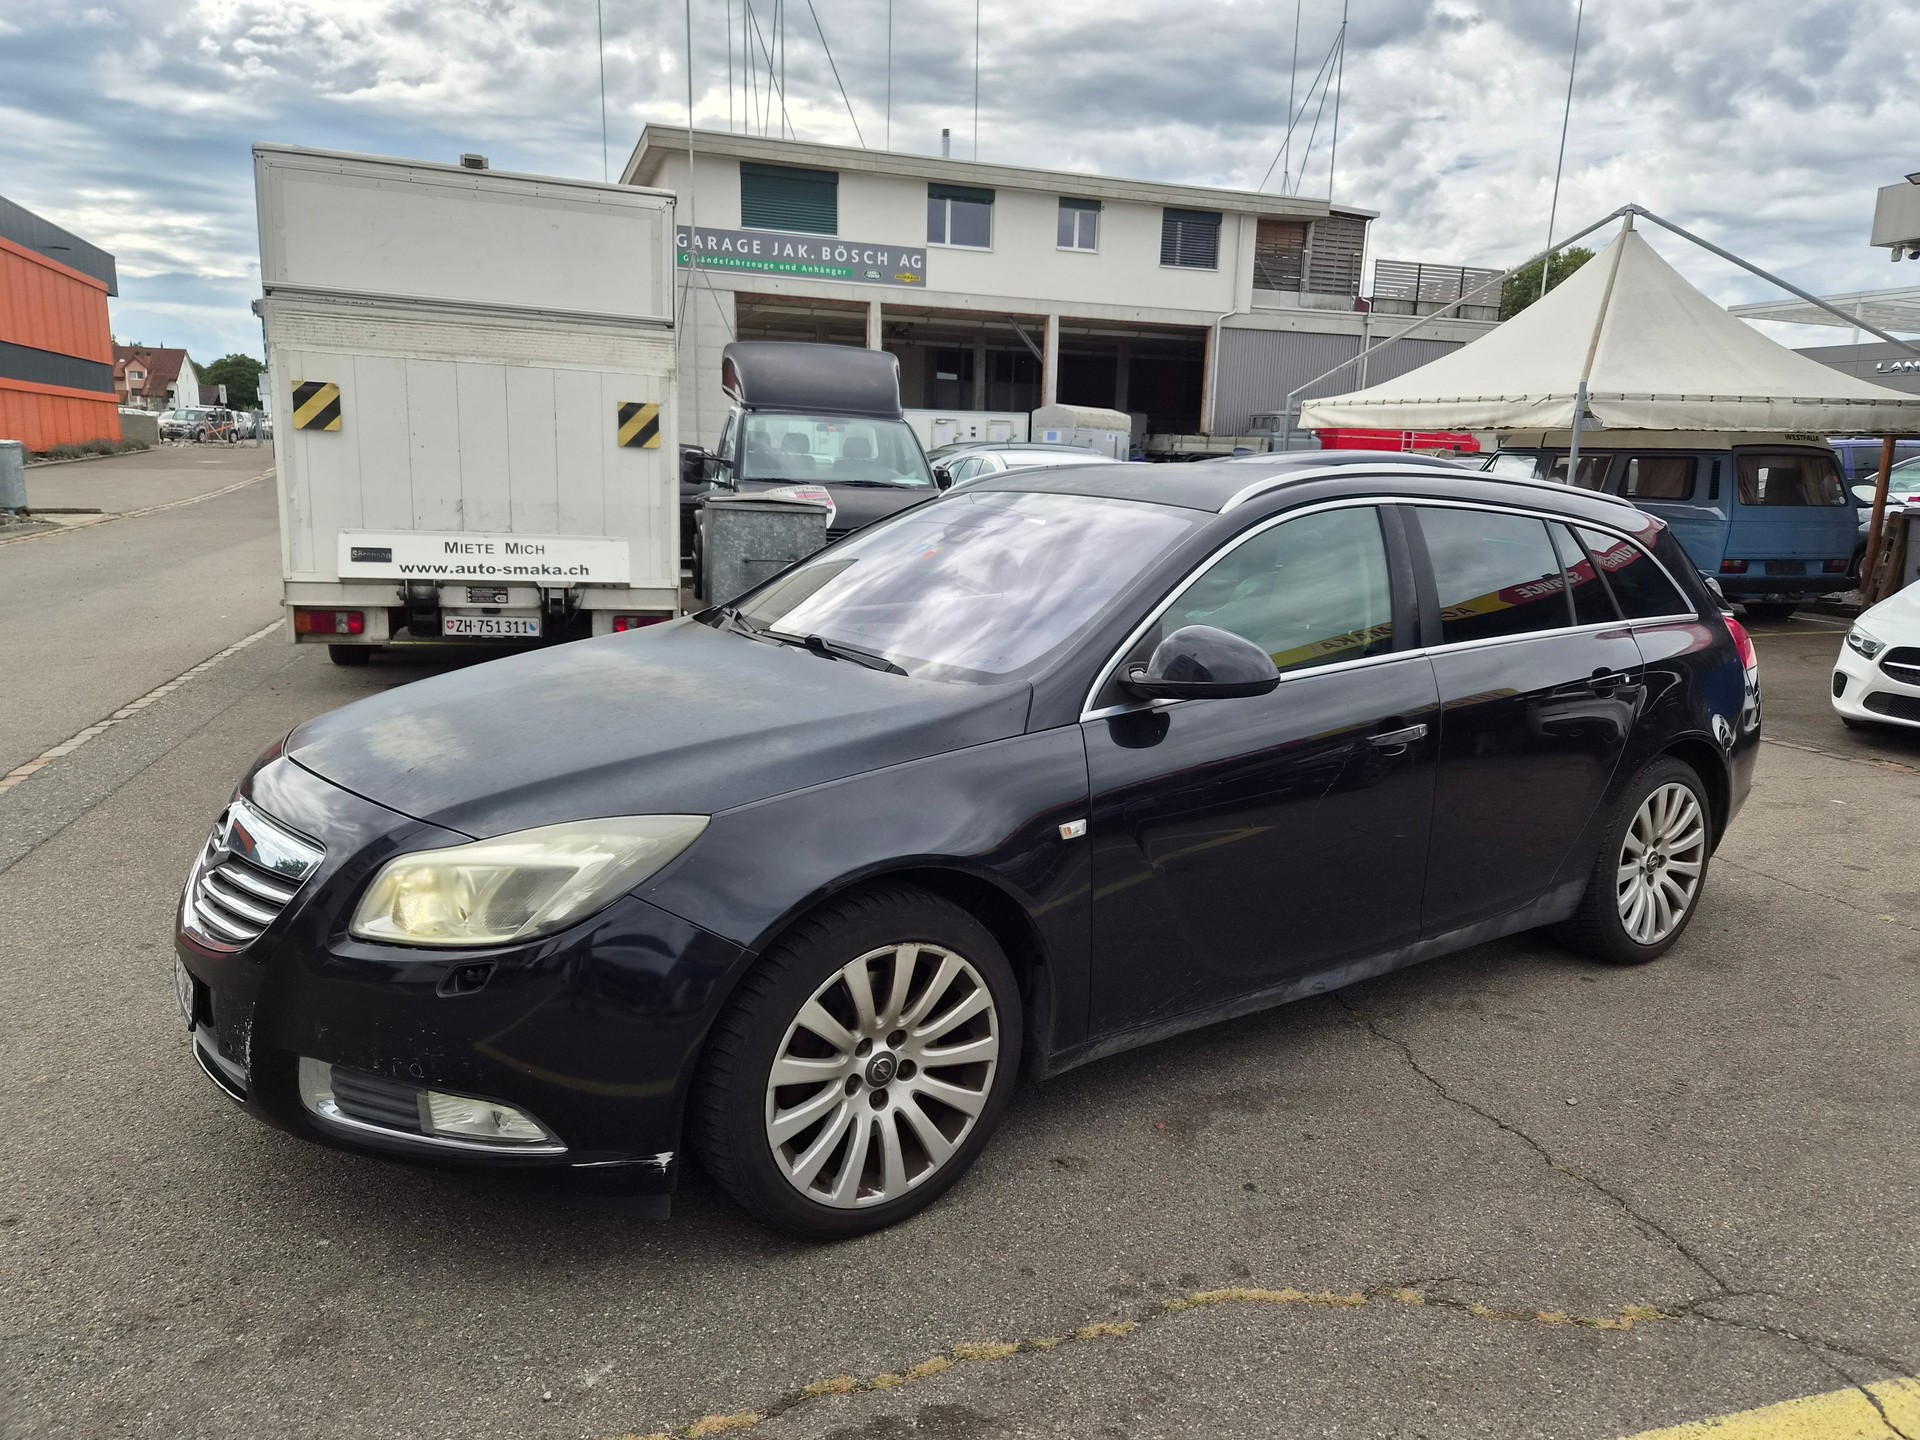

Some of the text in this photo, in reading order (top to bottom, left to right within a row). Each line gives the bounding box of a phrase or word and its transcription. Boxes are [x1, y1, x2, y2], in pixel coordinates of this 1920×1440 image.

[676, 233, 922, 269] GARAGE JAK. BÖSCH AG
[683, 254, 775, 271] Gändefahrzeuge
[801, 265, 847, 276] Anhänger
[1876, 360, 1920, 374] LAN
[1784, 433, 1820, 442] WESTFALIA
[399, 561, 590, 577] www.auto-smaka.ch
